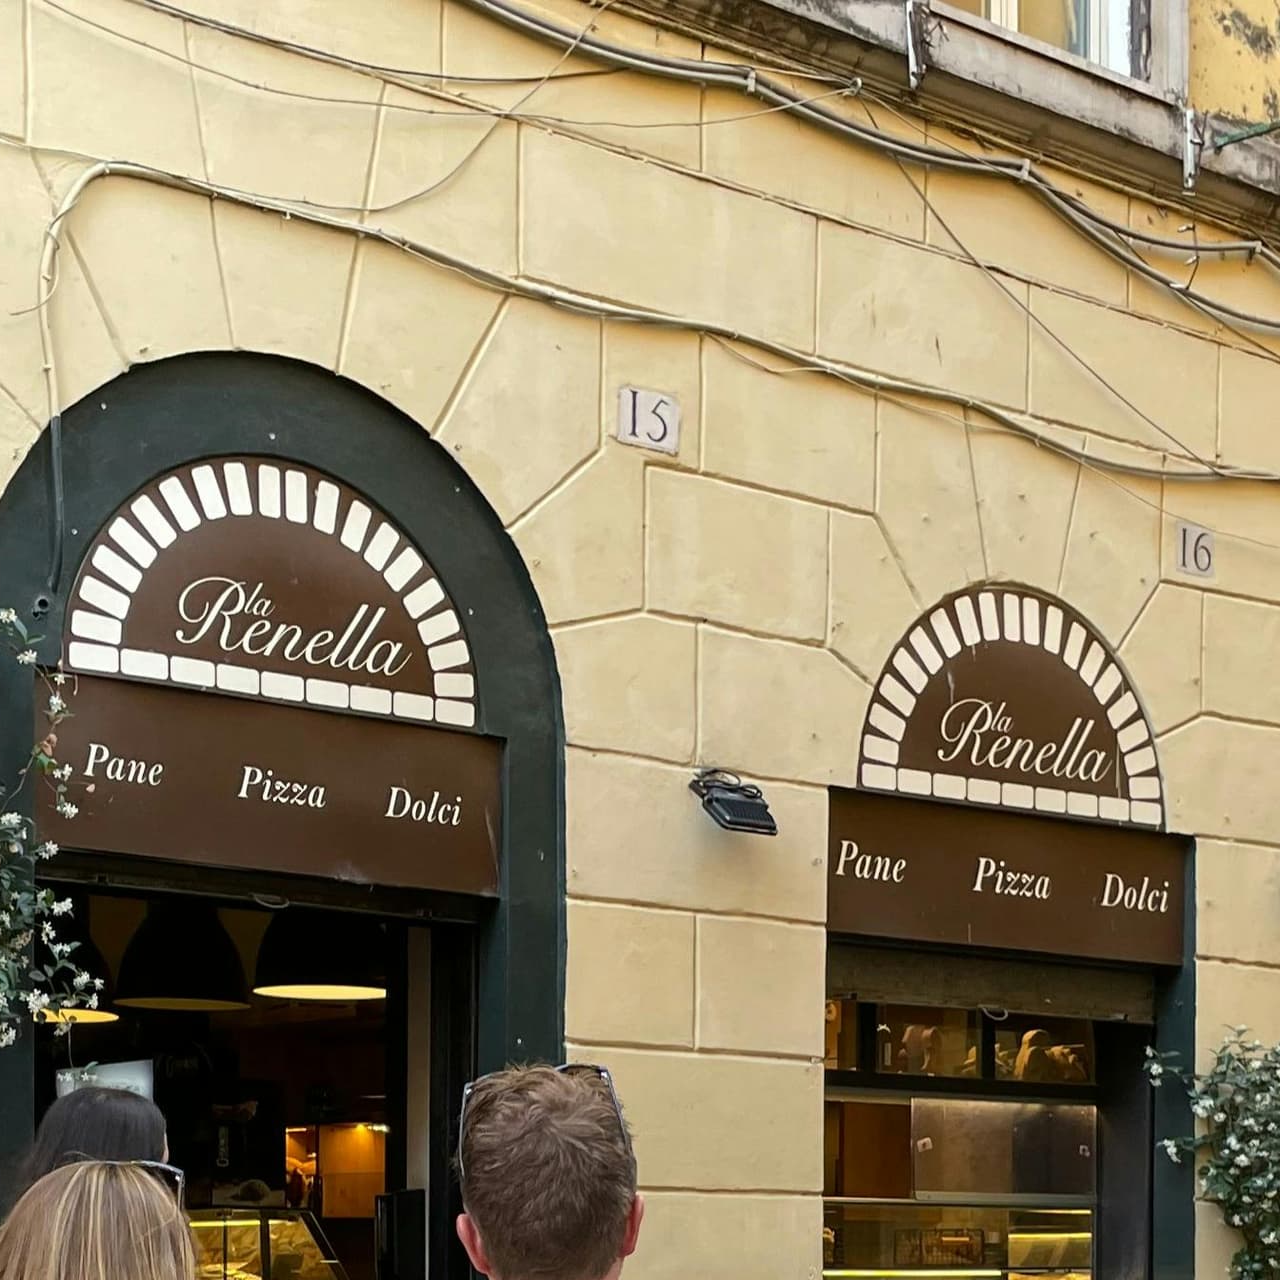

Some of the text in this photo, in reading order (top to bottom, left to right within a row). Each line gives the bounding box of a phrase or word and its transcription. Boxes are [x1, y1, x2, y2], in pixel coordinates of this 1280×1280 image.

[627, 389, 670, 443] 15
[1179, 527, 1212, 572] 16
[175, 576, 414, 677] Renella
[243, 581, 277, 617] la
[936, 698, 1112, 783] Renella
[990, 701, 1015, 734] la
[82, 743, 463, 827] Pane Pizza Dolci
[835, 839, 1170, 914] Pane Pizza Dolci
